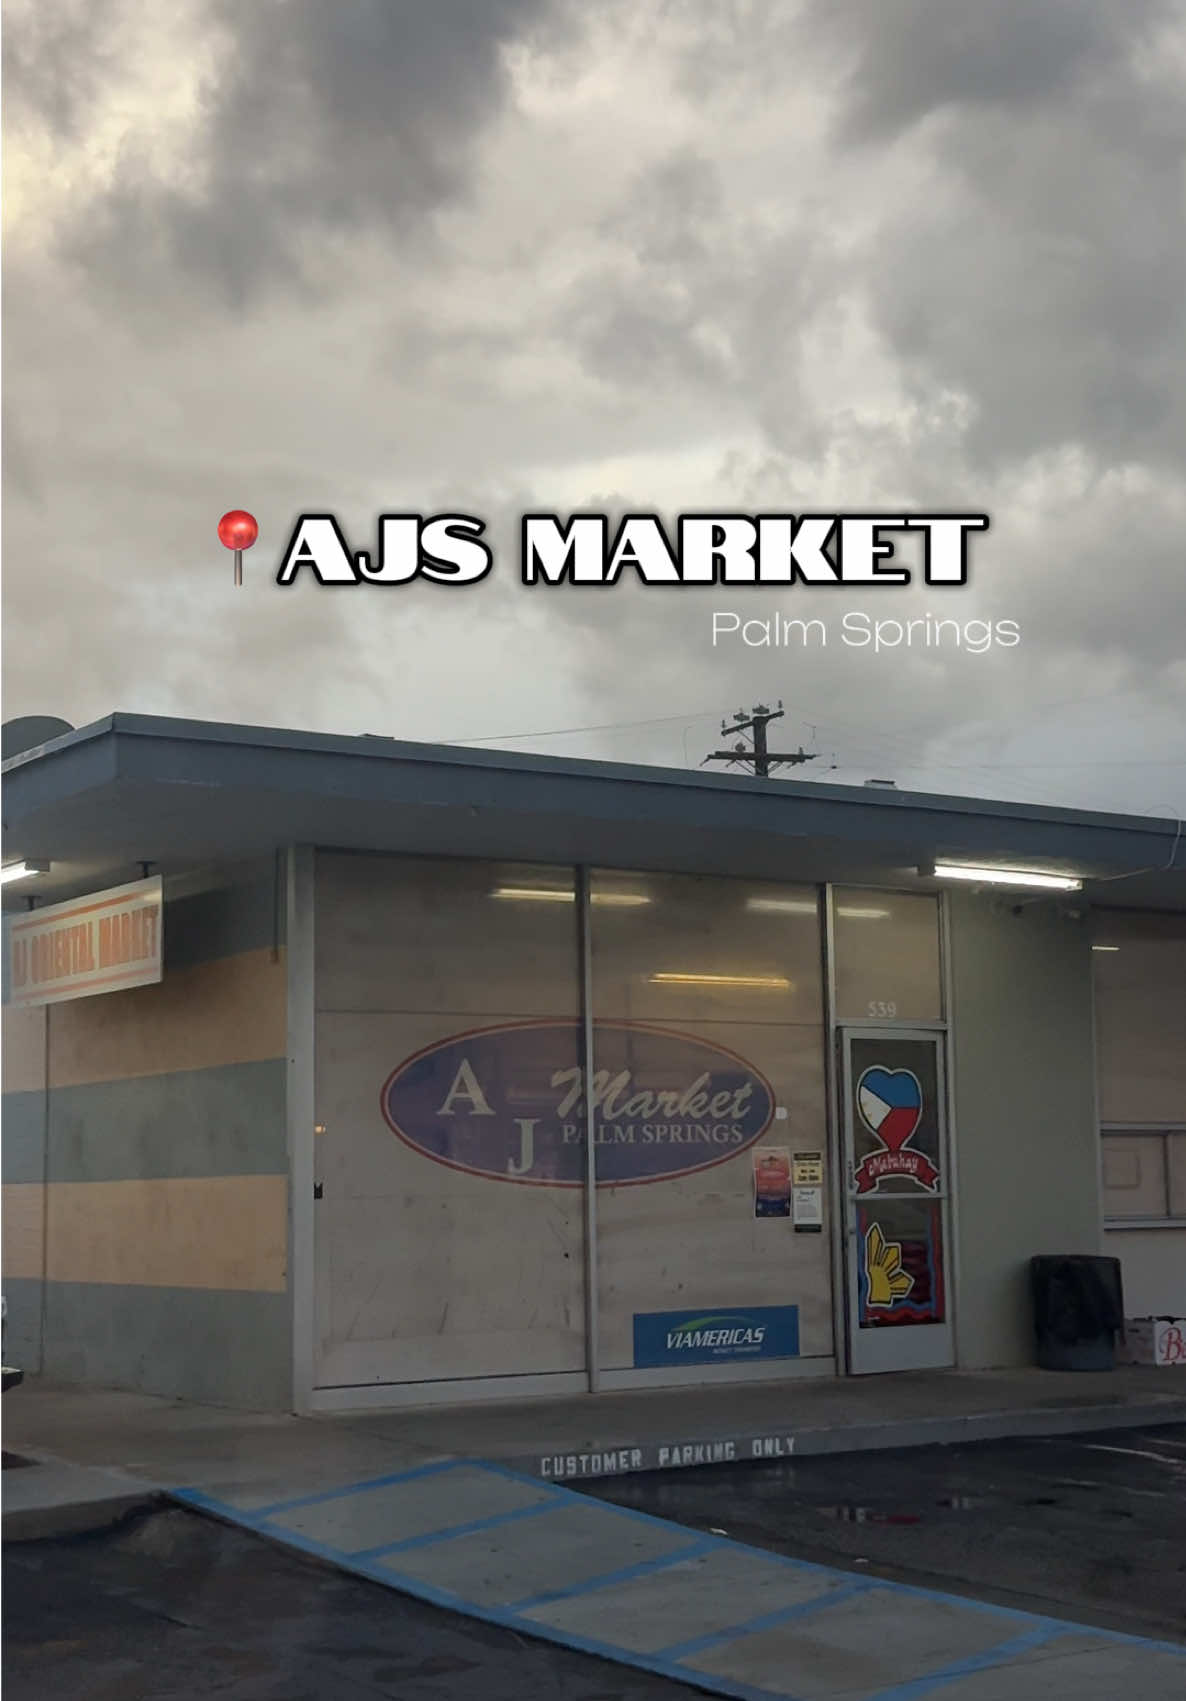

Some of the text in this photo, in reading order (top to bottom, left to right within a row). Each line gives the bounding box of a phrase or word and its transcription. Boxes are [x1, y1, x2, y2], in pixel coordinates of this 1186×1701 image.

[31, 920, 95, 985] ORIENTAL
[99, 903, 160, 969] MARKET
[868, 1002, 897, 1018] 539
[551, 1066, 754, 1120] Market
[436, 1058, 542, 1174] A J
[642, 1123, 743, 1144] SPRINGS
[666, 1327, 766, 1350] VIAMERICAS
[541, 1437, 795, 1477] CUSTOMER PARKING ONLY
